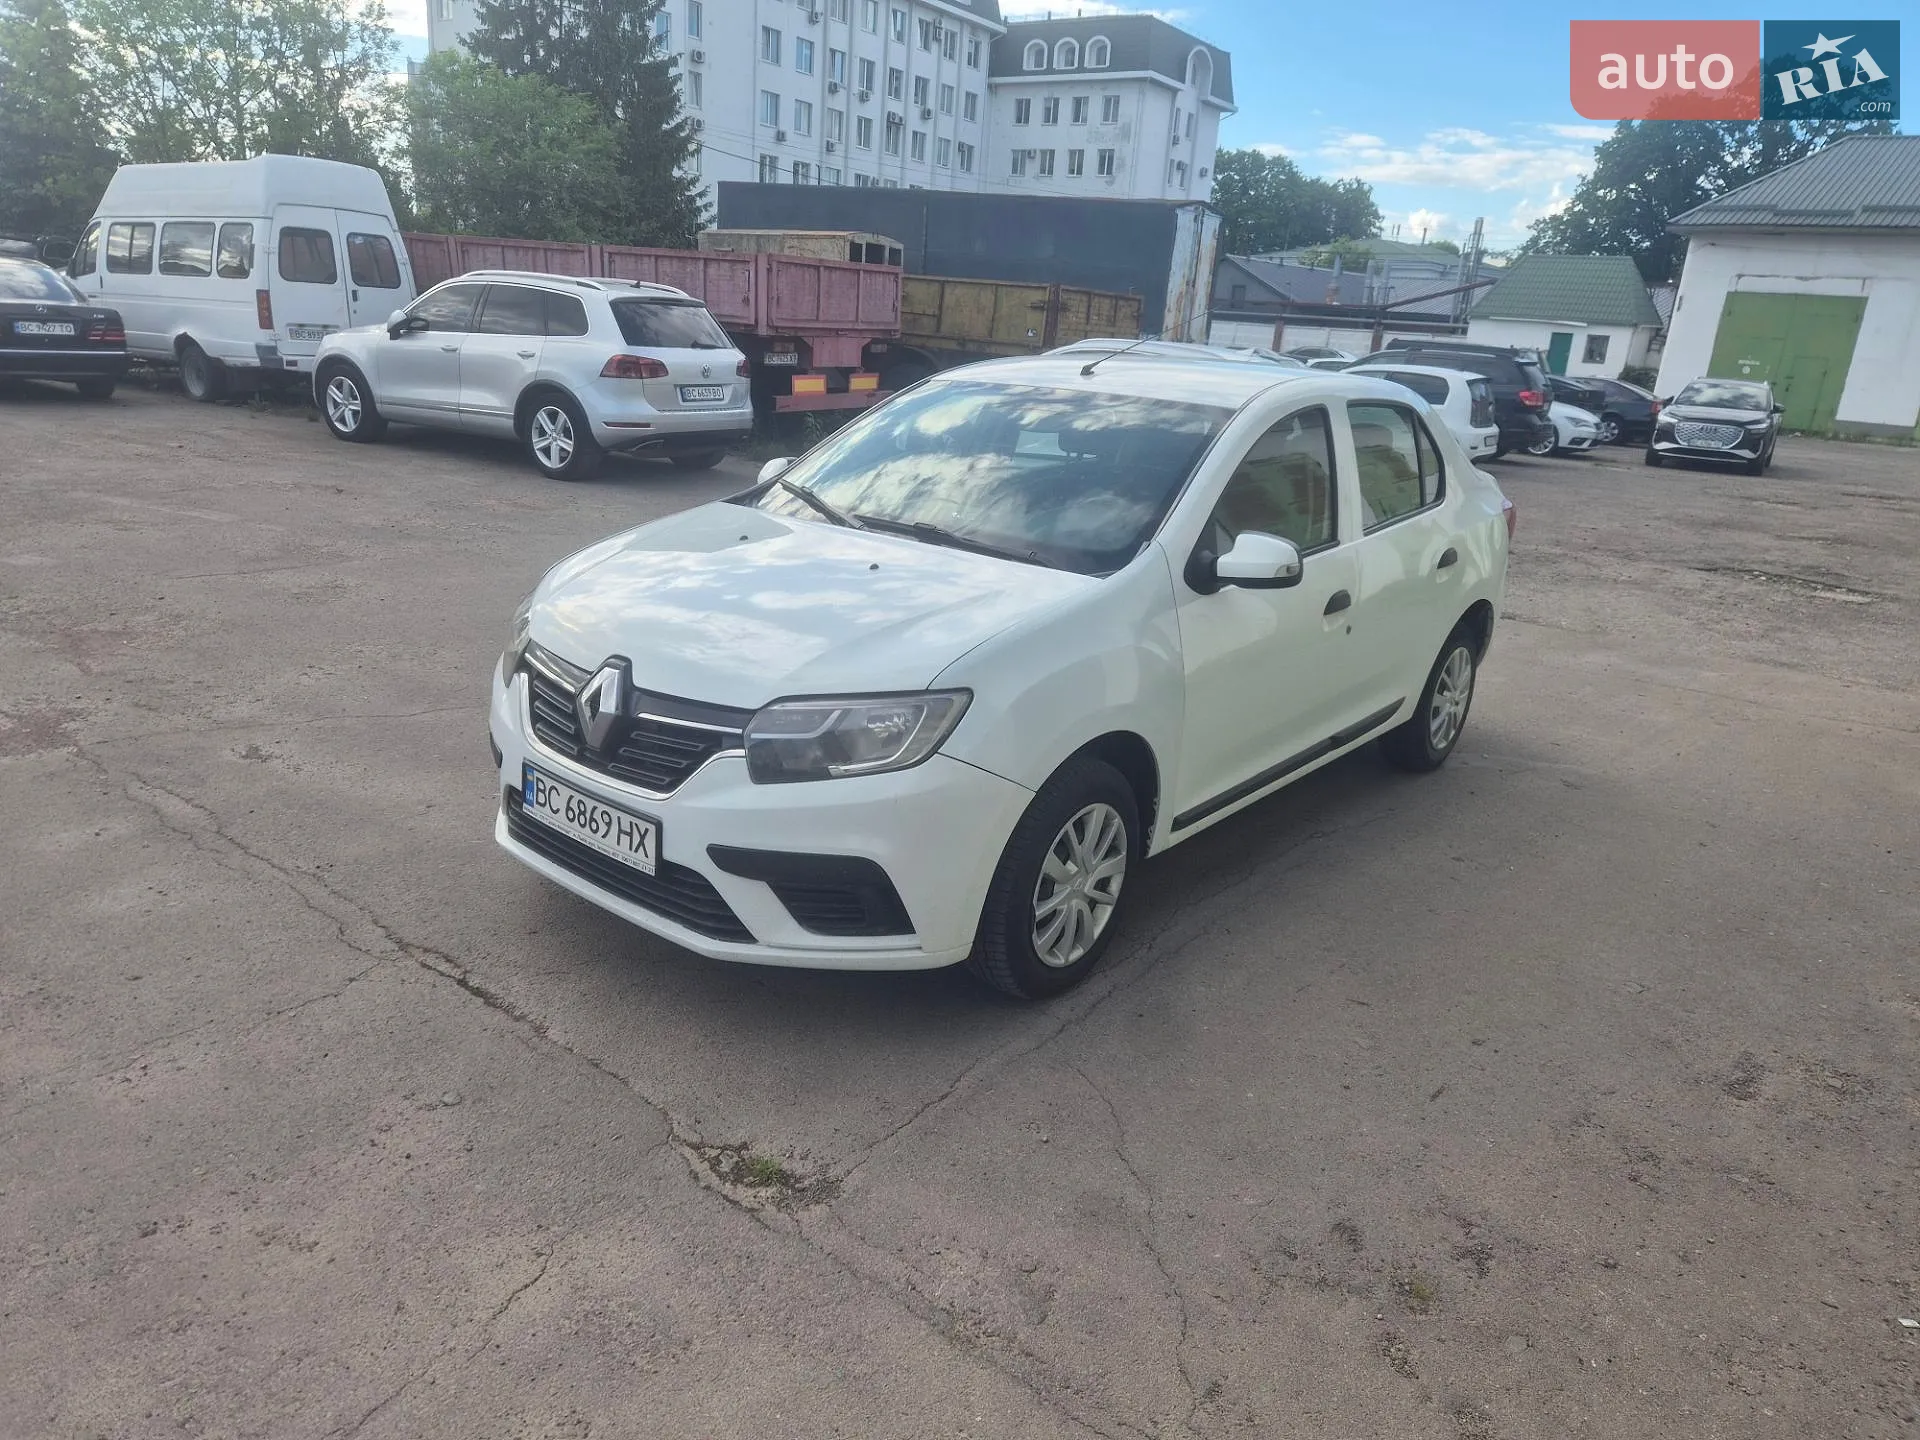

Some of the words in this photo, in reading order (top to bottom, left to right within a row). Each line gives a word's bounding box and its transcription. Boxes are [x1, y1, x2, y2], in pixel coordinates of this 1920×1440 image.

[686, 388, 697, 398] BC
[535, 776, 560, 814] BC
[565, 794, 612, 839] 6869
[616, 816, 649, 859] HX
